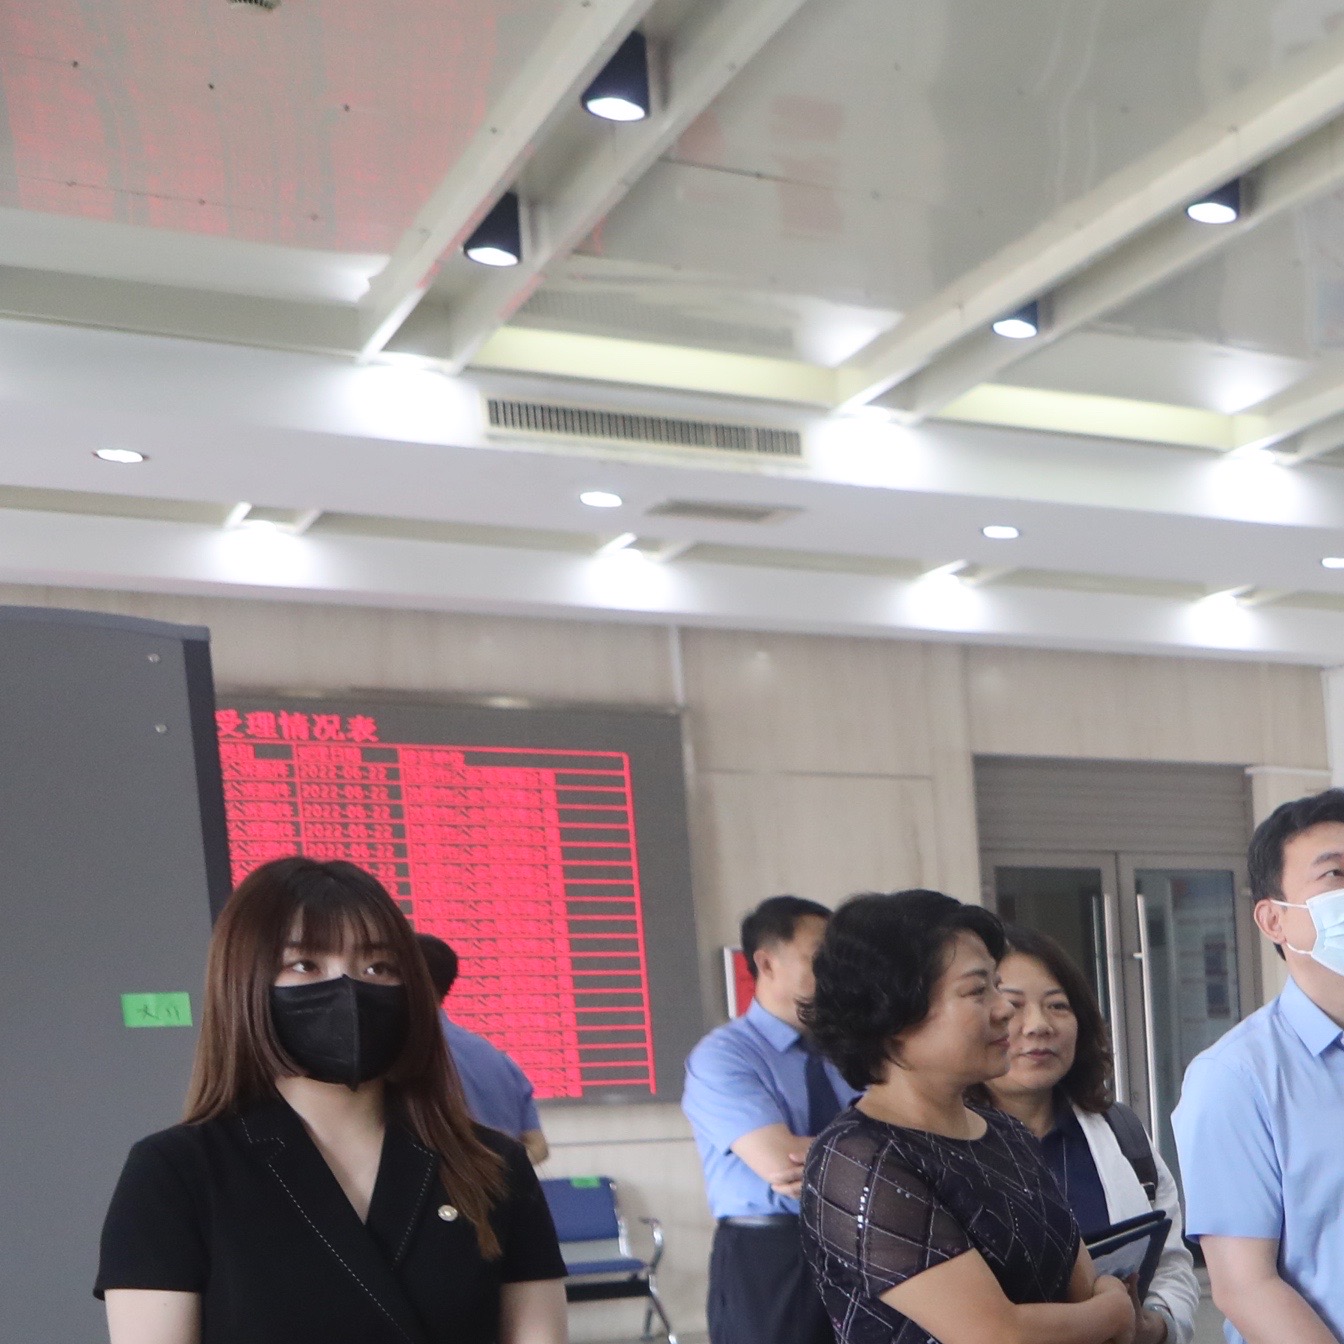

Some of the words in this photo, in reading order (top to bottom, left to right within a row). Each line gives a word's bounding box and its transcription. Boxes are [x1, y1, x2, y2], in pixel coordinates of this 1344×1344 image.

[214, 709, 379, 742] 受理情况表
